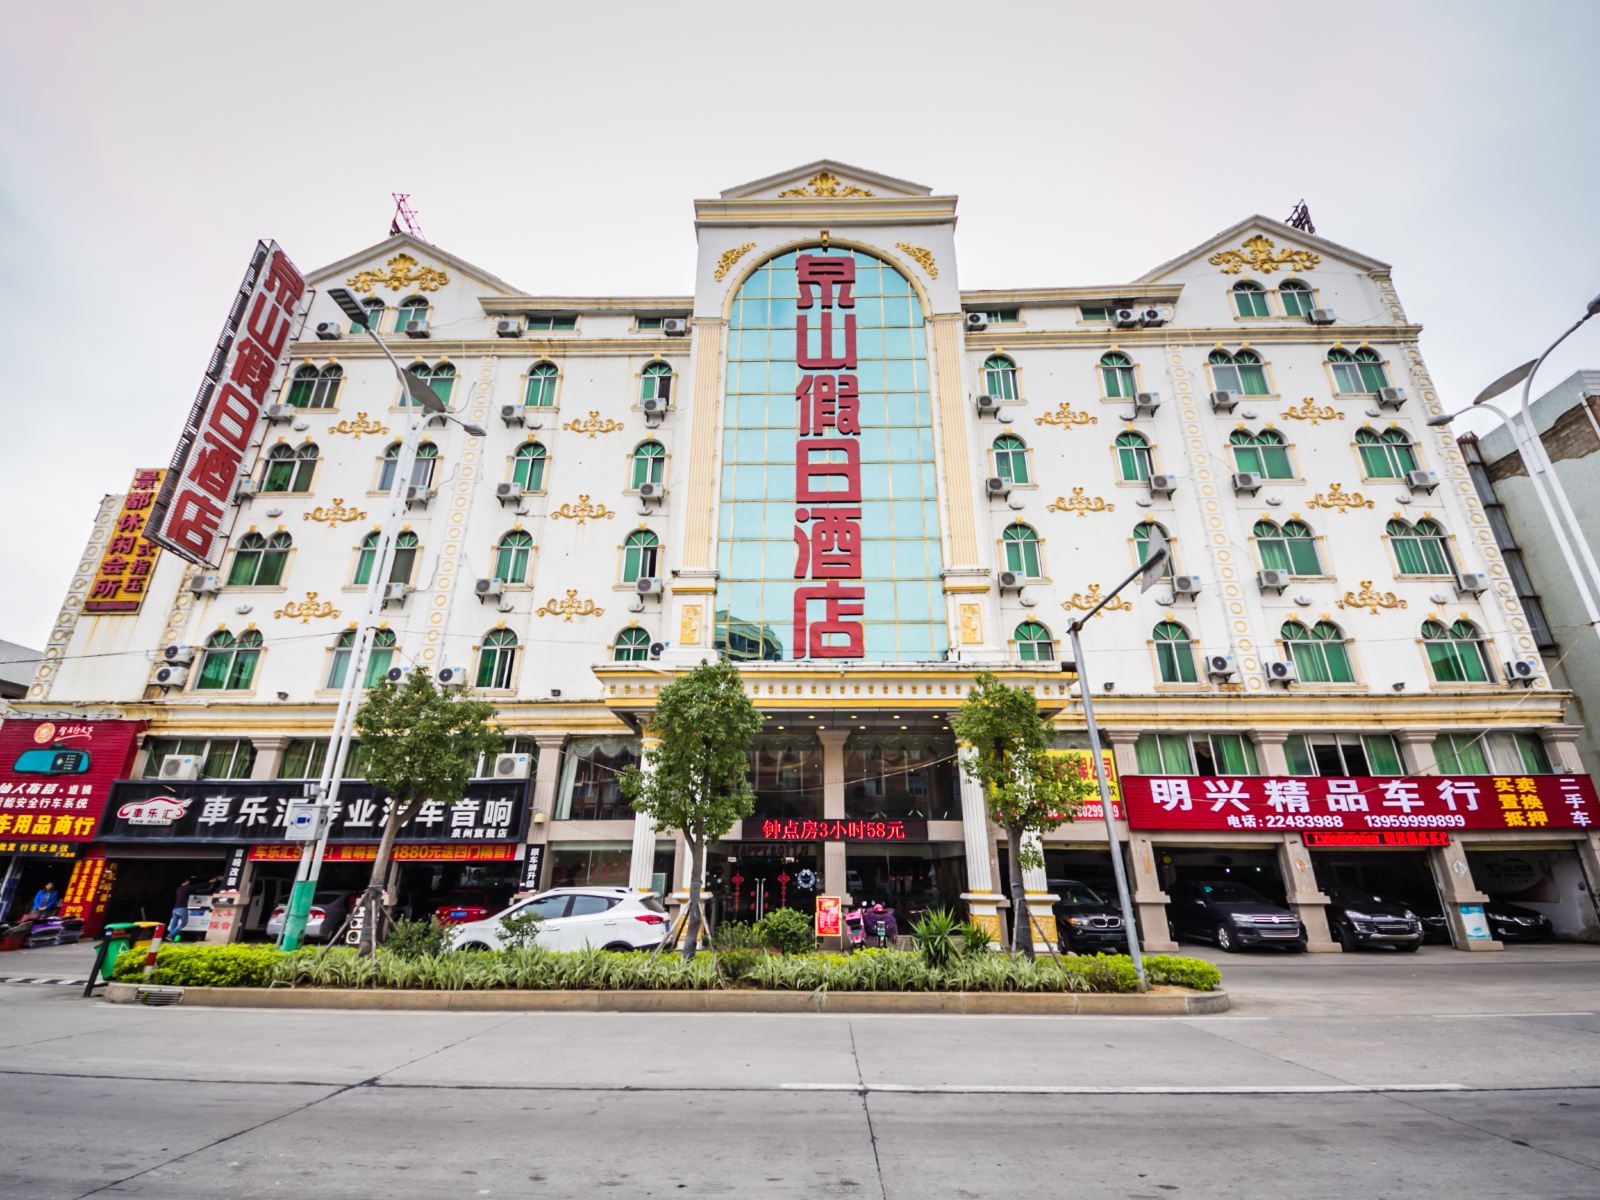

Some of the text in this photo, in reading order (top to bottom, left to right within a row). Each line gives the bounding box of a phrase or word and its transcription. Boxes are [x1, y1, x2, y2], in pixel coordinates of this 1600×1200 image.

[1493, 777, 1537, 793] 买卖
[1150, 779, 1480, 812] 明兴精品车行
[1498, 794, 1544, 809] 置换
[1559, 778, 1592, 827] 二手车
[1364, 814, 1466, 827] 13959999899
[1503, 811, 1549, 827] 抵押
[451, 828, 508, 839] 泉州旗舰店
[762, 819, 905, 840] 钟点房3小时58元
